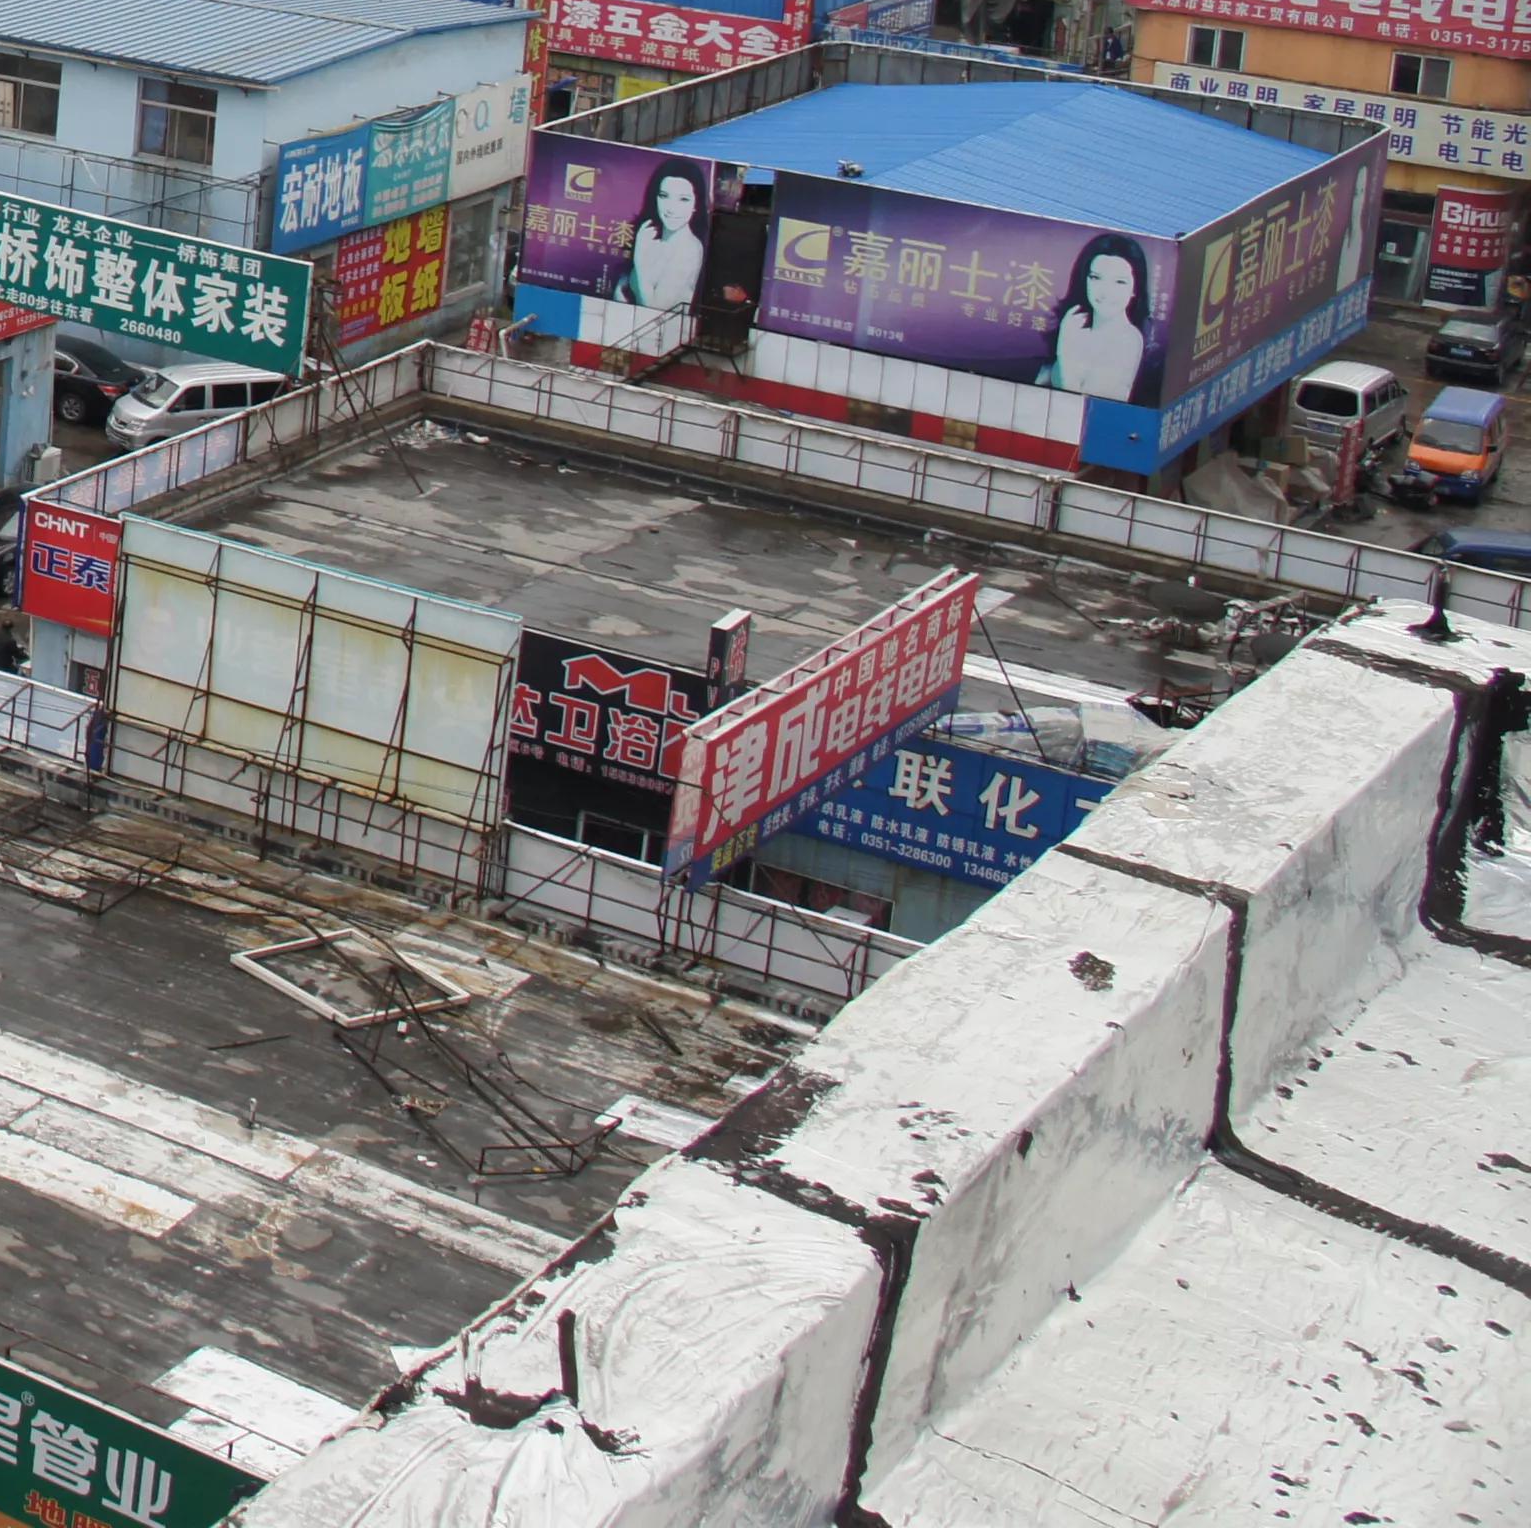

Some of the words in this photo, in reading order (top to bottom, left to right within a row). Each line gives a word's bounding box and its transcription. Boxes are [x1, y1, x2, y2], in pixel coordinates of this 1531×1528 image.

[587, 30, 627, 51] 拉手
[639, 40, 701, 65] 波音纸
[1169, 72, 1279, 105] 商业照明
[1302, 92, 1418, 130] 家居照明
[1440, 112, 1529, 146] 节能光
[1437, 140, 1526, 173] 电工电
[279, 146, 365, 235] 宏耐地板
[524, 202, 634, 249] 嘉丽士漆
[1233, 175, 1338, 306] 嘉丽士漆
[842, 228, 1056, 314] 嘉丽士漆
[119, 316, 182, 346] 2660480
[960, 301, 1048, 333] 专业好漆
[30, 542, 114, 596] 正泰
[832, 596, 964, 700] 中国驰名商标
[826, 635, 960, 756] 电线电缆
[703, 678, 829, 846] 津成
[817, 819, 853, 842] 电话:
[860, 832, 952, 870] 0351-3286300
[870, 813, 929, 845] 防水乳液
[935, 830, 996, 865] 防锈乳液
[1002, 846, 1035, 870] 水性
